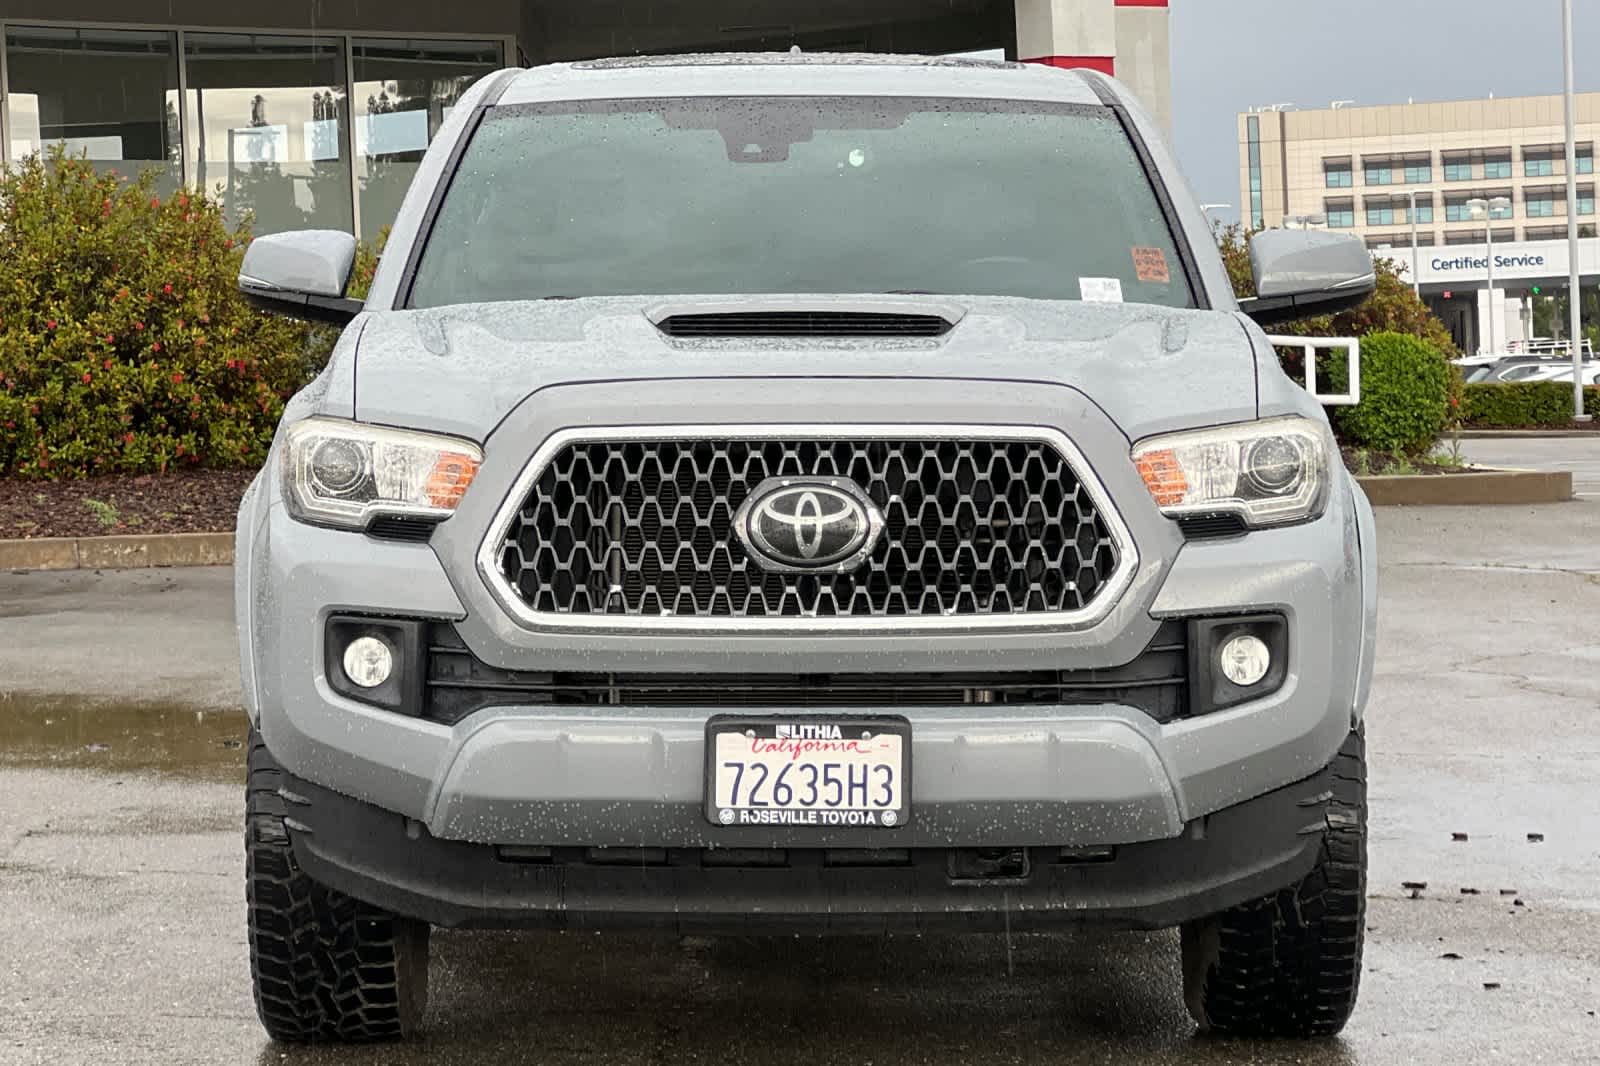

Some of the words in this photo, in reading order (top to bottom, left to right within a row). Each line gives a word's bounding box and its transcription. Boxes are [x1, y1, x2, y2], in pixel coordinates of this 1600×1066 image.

[1431, 256, 1488, 271] Certified
[1494, 253, 1544, 267] Service
[792, 725, 842, 739] LITHIA
[752, 737, 872, 760] California
[724, 763, 893, 806] 72635H3
[740, 811, 817, 824] ROSEVILLE
[820, 811, 876, 824] TOYOTA
